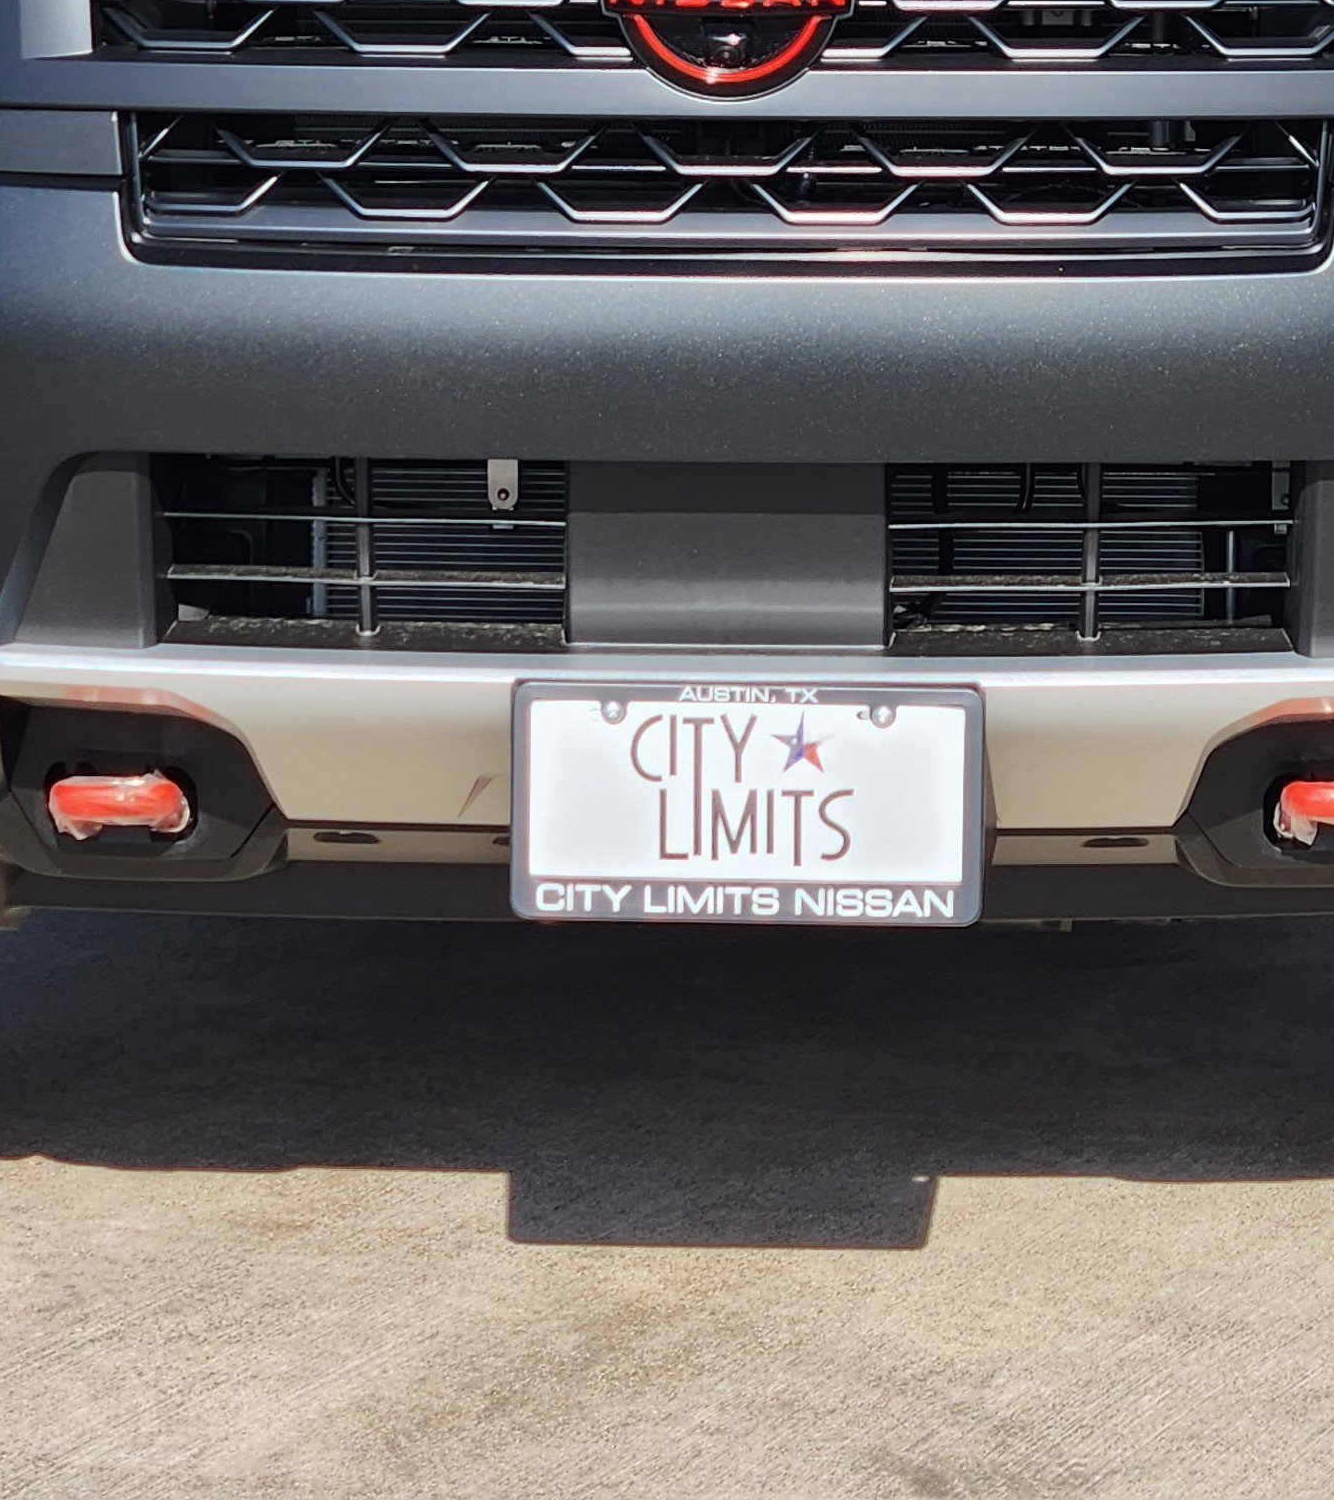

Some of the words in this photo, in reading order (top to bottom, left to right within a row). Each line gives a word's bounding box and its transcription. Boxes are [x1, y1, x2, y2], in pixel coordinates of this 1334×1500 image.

[678, 686, 777, 704] AUSTIN,
[786, 687, 819, 704] TX
[630, 713, 758, 787] CITY
[658, 787, 855, 867] LIMITS
[535, 883, 632, 912] CITY
[643, 884, 780, 916] LIMITS
[794, 887, 955, 919] NISSAN
